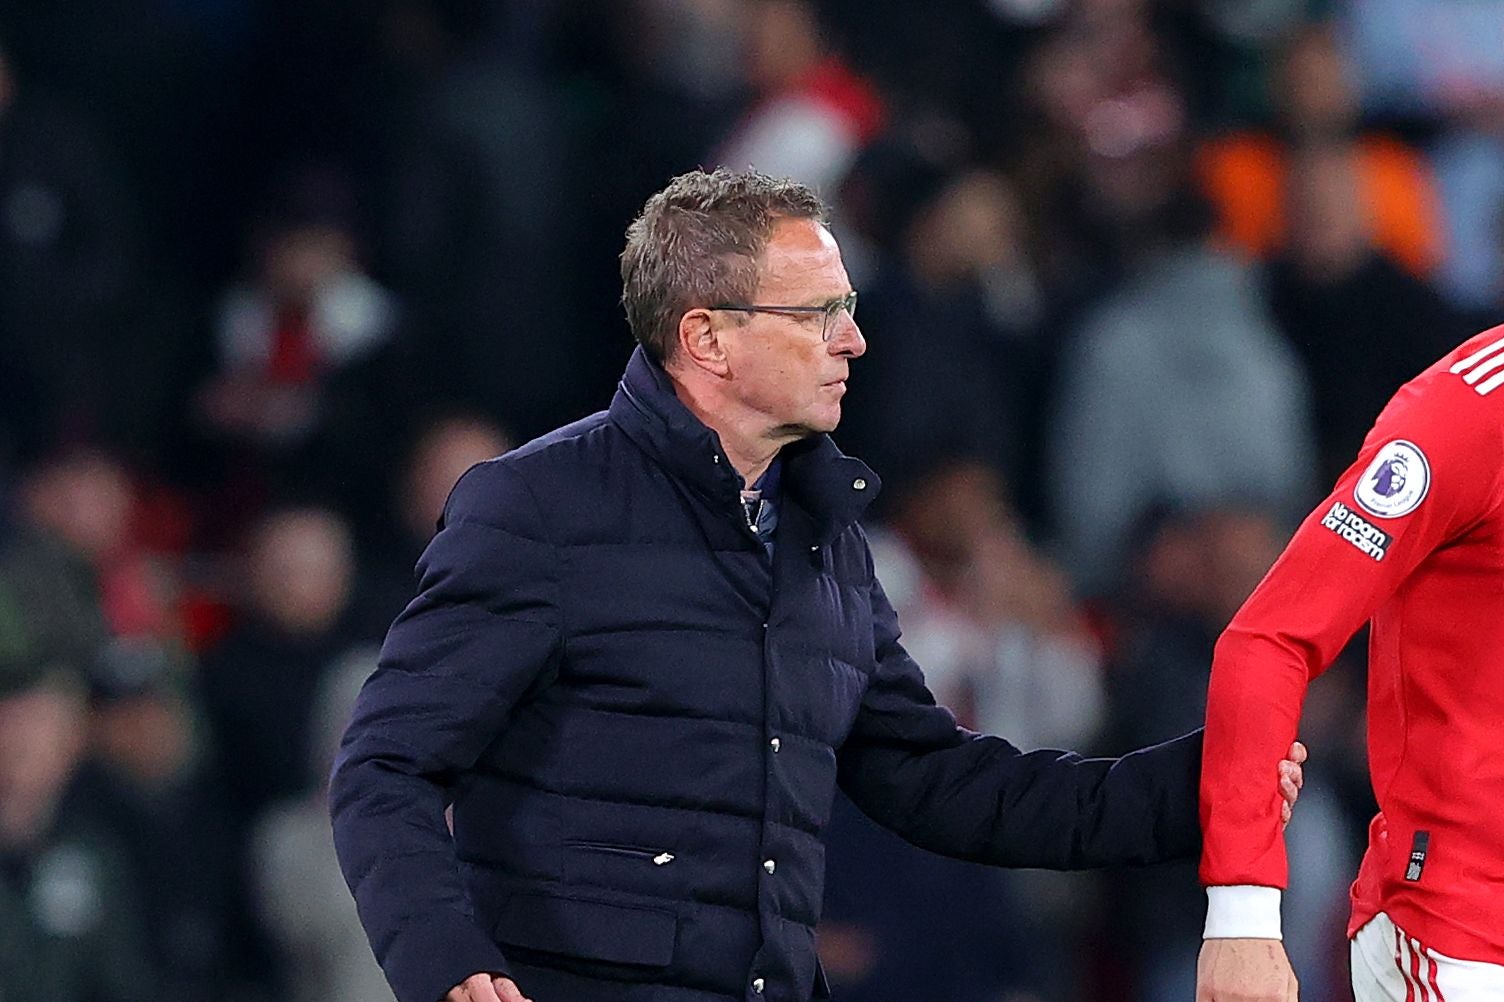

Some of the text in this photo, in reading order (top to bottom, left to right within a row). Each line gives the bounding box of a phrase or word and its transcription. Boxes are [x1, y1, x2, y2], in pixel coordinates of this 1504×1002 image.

[1321, 515, 1385, 562] for racism
[1327, 501, 1386, 547] No room
